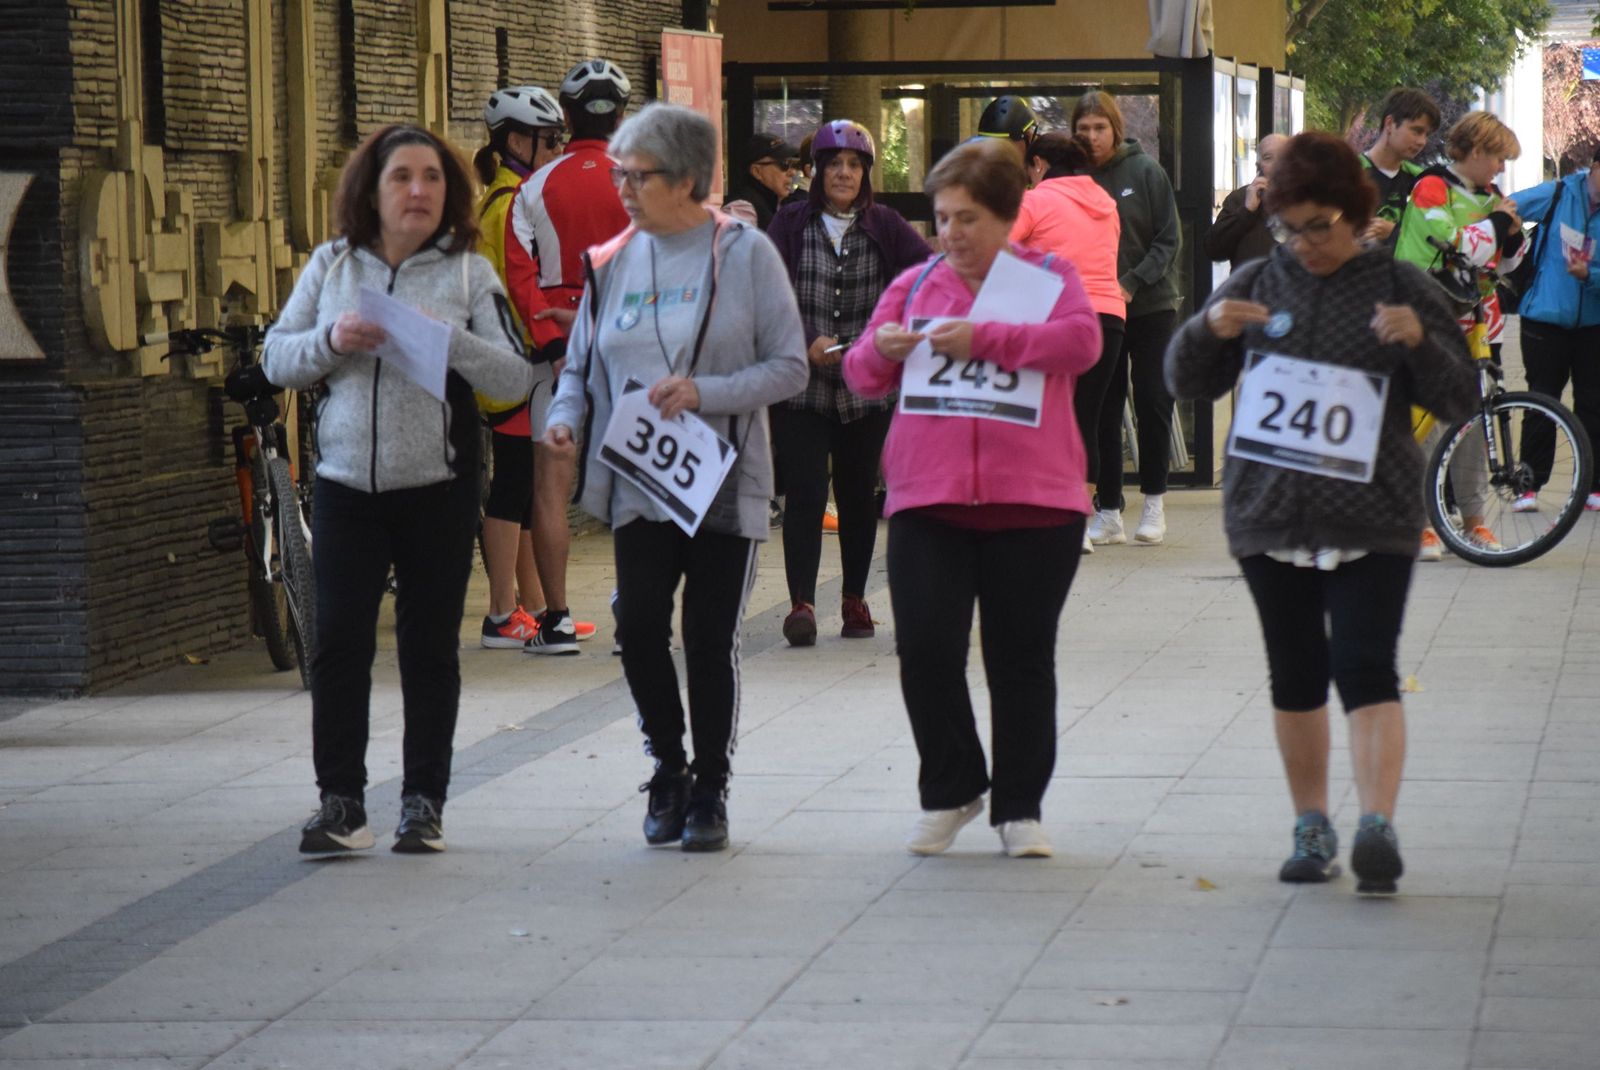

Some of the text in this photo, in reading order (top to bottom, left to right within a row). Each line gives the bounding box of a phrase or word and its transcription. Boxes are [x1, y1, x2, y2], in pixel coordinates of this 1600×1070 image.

[928, 351, 1020, 393] 245
[1258, 390, 1355, 446] 240
[625, 415, 702, 491] 395
